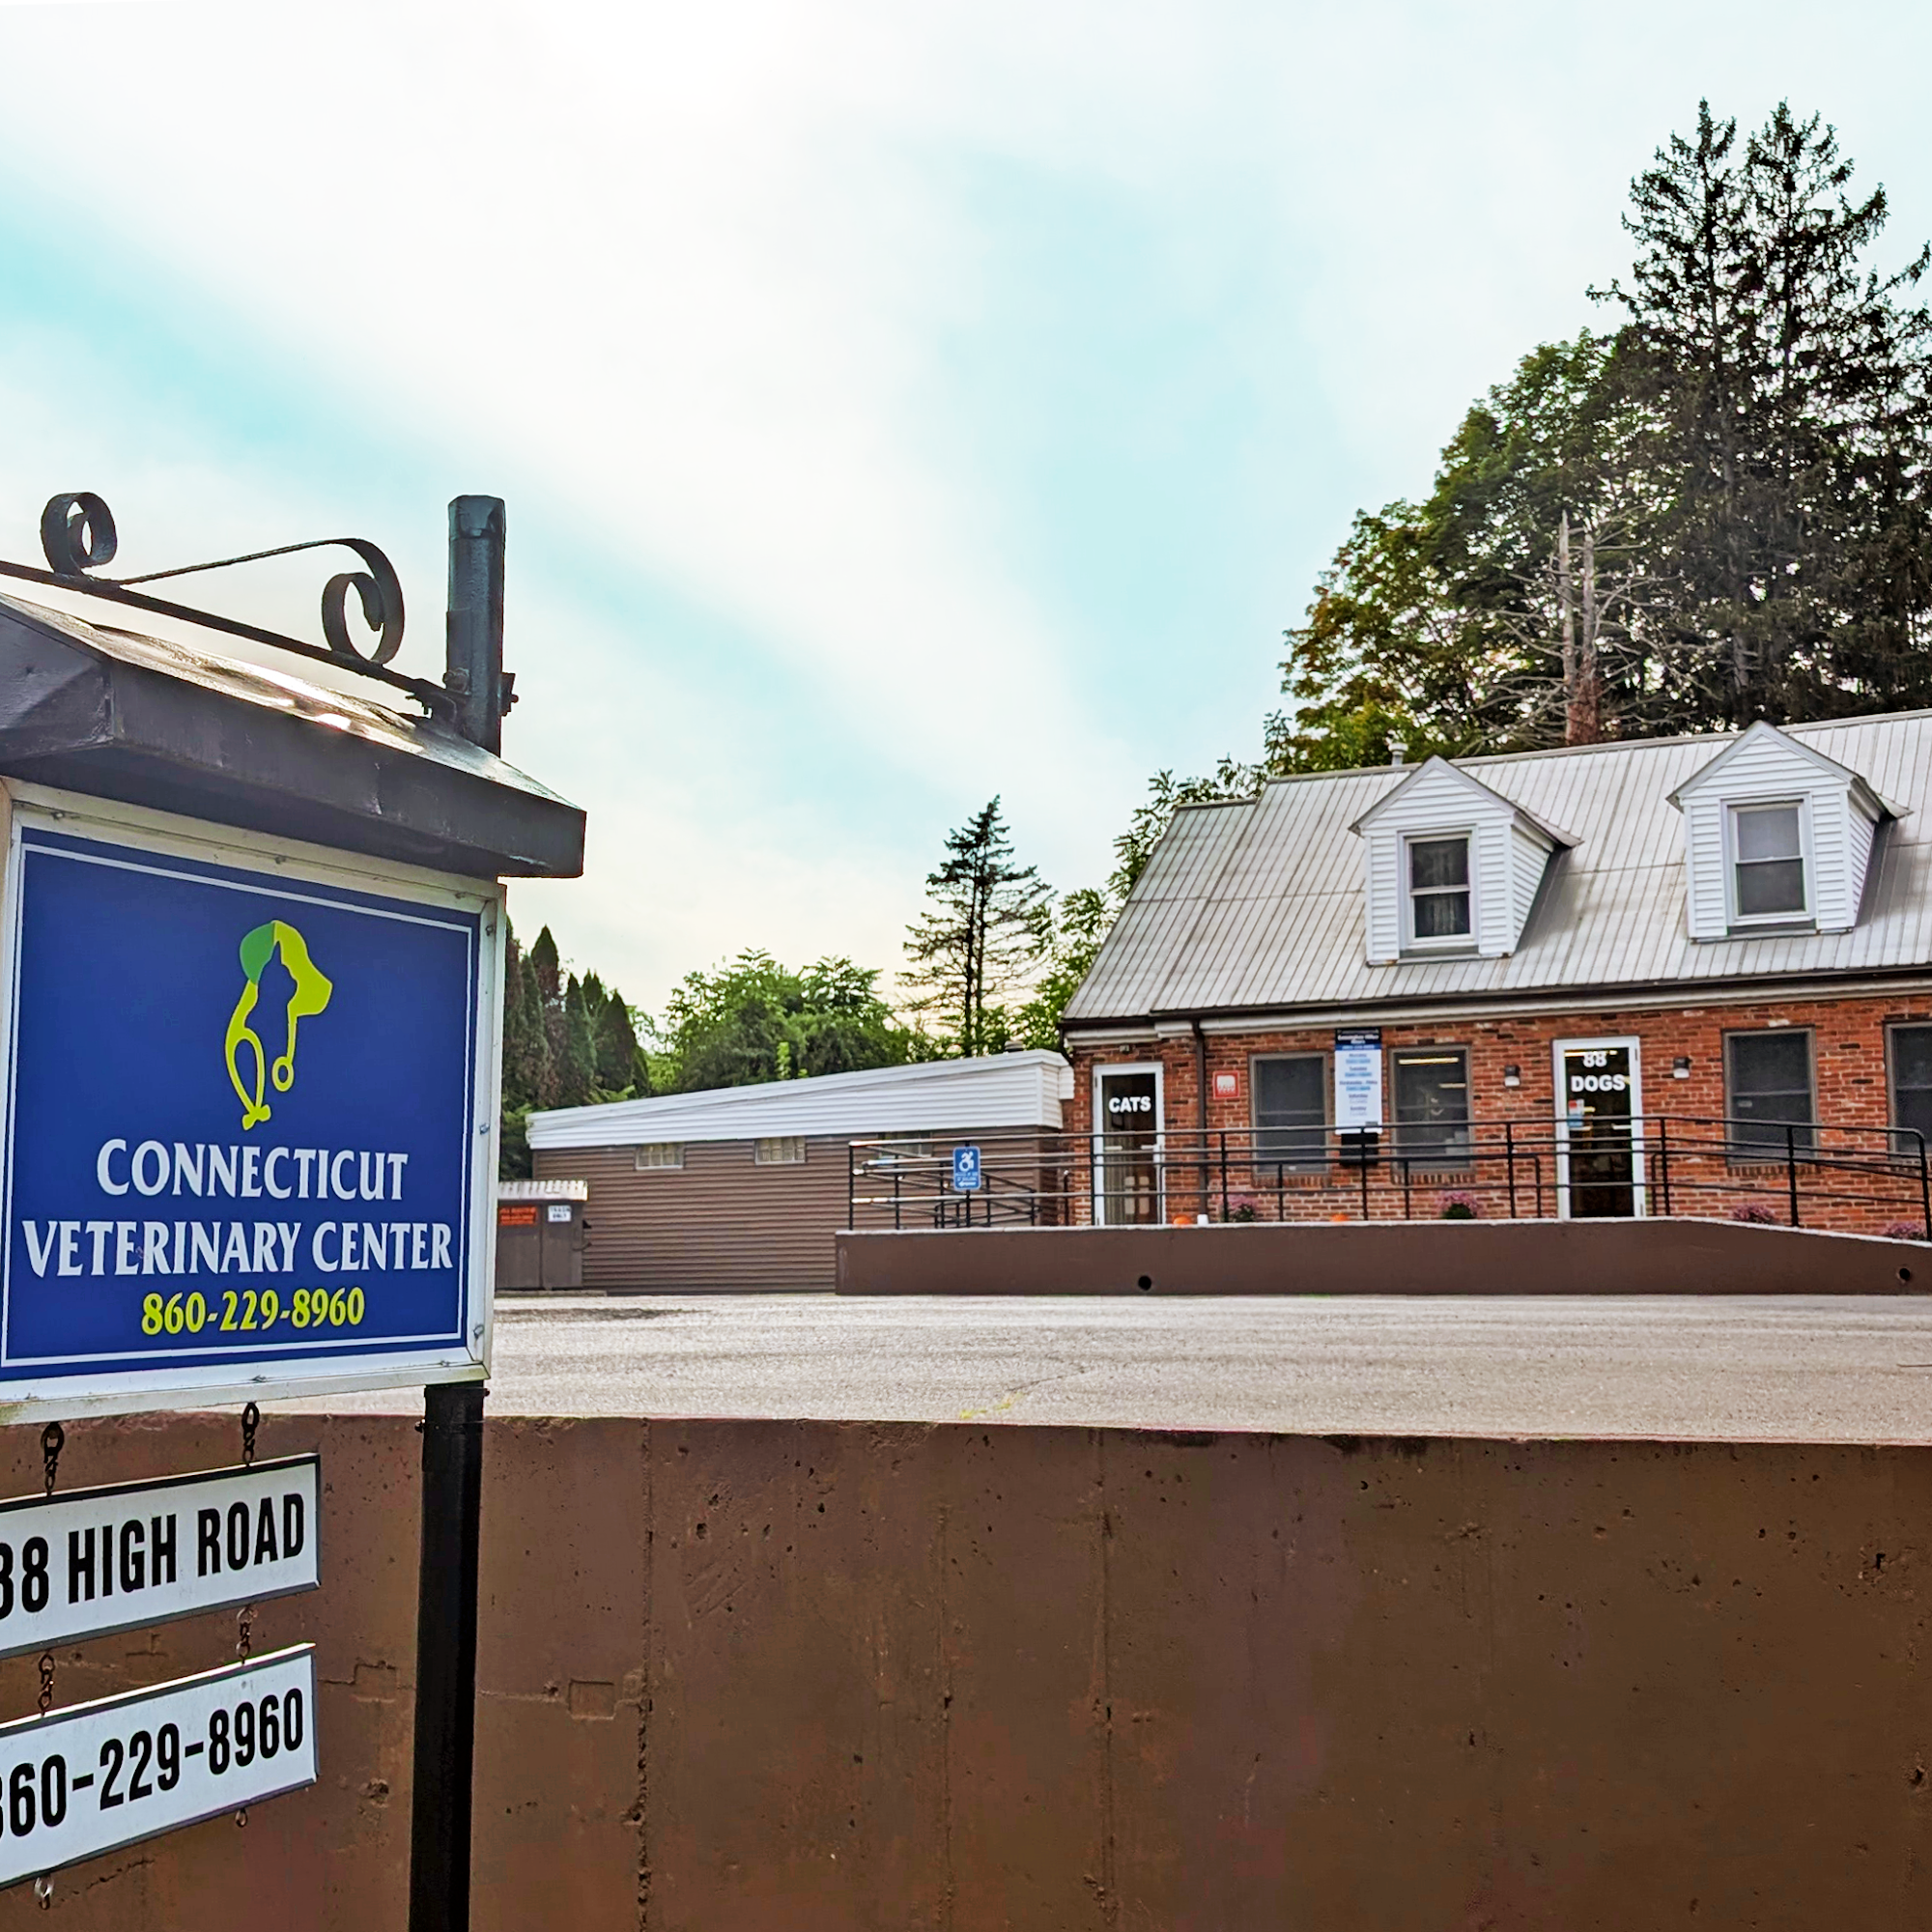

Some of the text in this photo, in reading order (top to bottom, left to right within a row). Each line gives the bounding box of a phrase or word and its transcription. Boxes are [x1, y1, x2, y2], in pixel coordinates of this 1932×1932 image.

[1571, 1074, 1626, 1093] DOGS
[1582, 1051, 1607, 1067] 88
[1109, 1095, 1152, 1113] CATS
[97, 1138, 409, 1202] CONNECTICUT
[22, 1219, 454, 1278] VETERINARY CENTER
[141, 1286, 366, 1336] 860-229-8960
[68, 1514, 178, 1605] HIGH
[197, 1492, 305, 1578] ROAD
[0, 1688, 304, 1839] 60-229-8960
